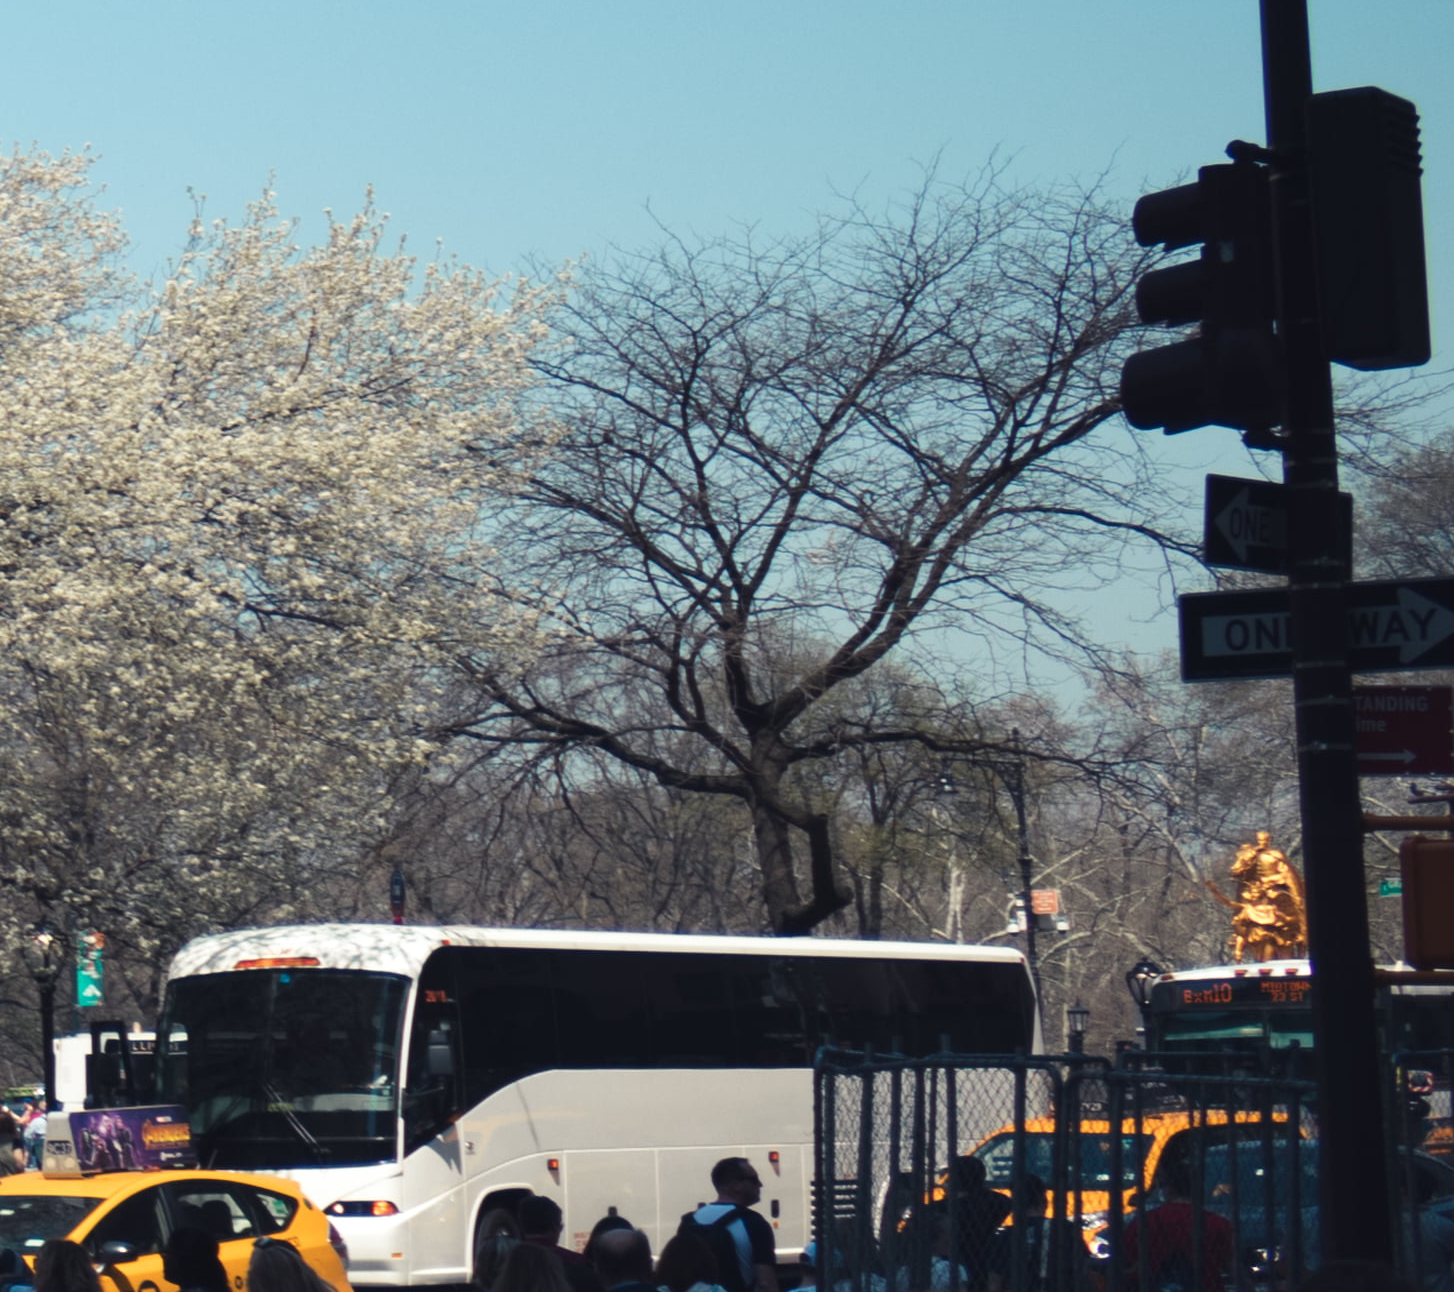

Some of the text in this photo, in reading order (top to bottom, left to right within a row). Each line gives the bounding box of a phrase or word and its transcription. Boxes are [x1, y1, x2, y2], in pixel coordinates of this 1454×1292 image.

[1230, 507, 1269, 543] ONE
[1225, 607, 1438, 652] ON WAY
[1183, 982, 1232, 1004] BxM10
